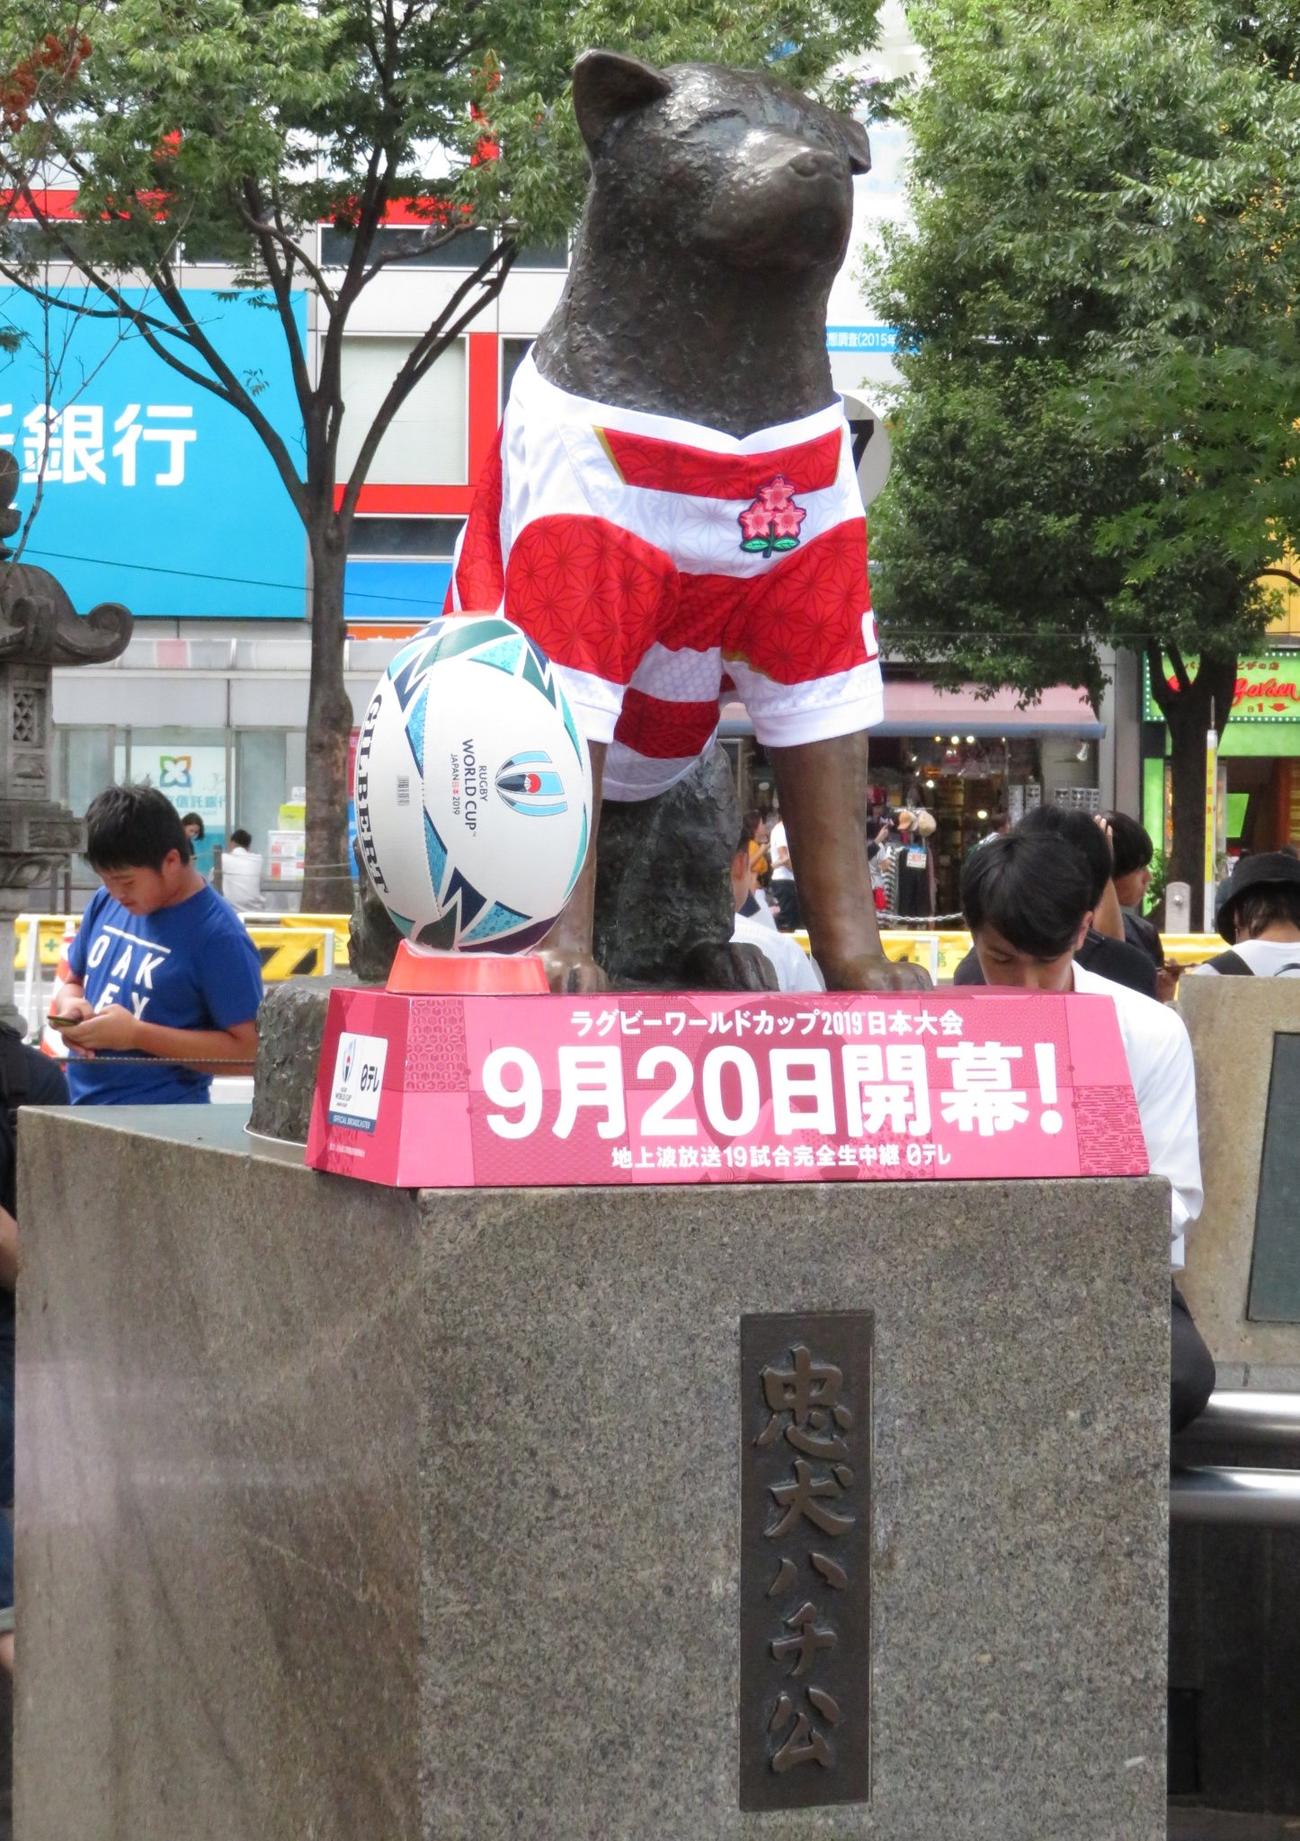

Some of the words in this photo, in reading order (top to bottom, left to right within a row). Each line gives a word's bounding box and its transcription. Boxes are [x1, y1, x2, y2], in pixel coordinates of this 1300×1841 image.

[0, 404, 197, 486] 銀行
[358, 694, 390, 894] GILBERT
[451, 753, 460, 780] JAPAN
[462, 739, 476, 797] WORLD
[479, 765, 488, 801] RUGBY
[452, 796, 460, 815] 2019
[465, 800, 477, 831] CUP
[87, 935, 166, 990] OAK
[481, 1041, 1063, 1140] 9月20日開幕!
[752, 1345, 855, 1773] 忠犬ハチ公
